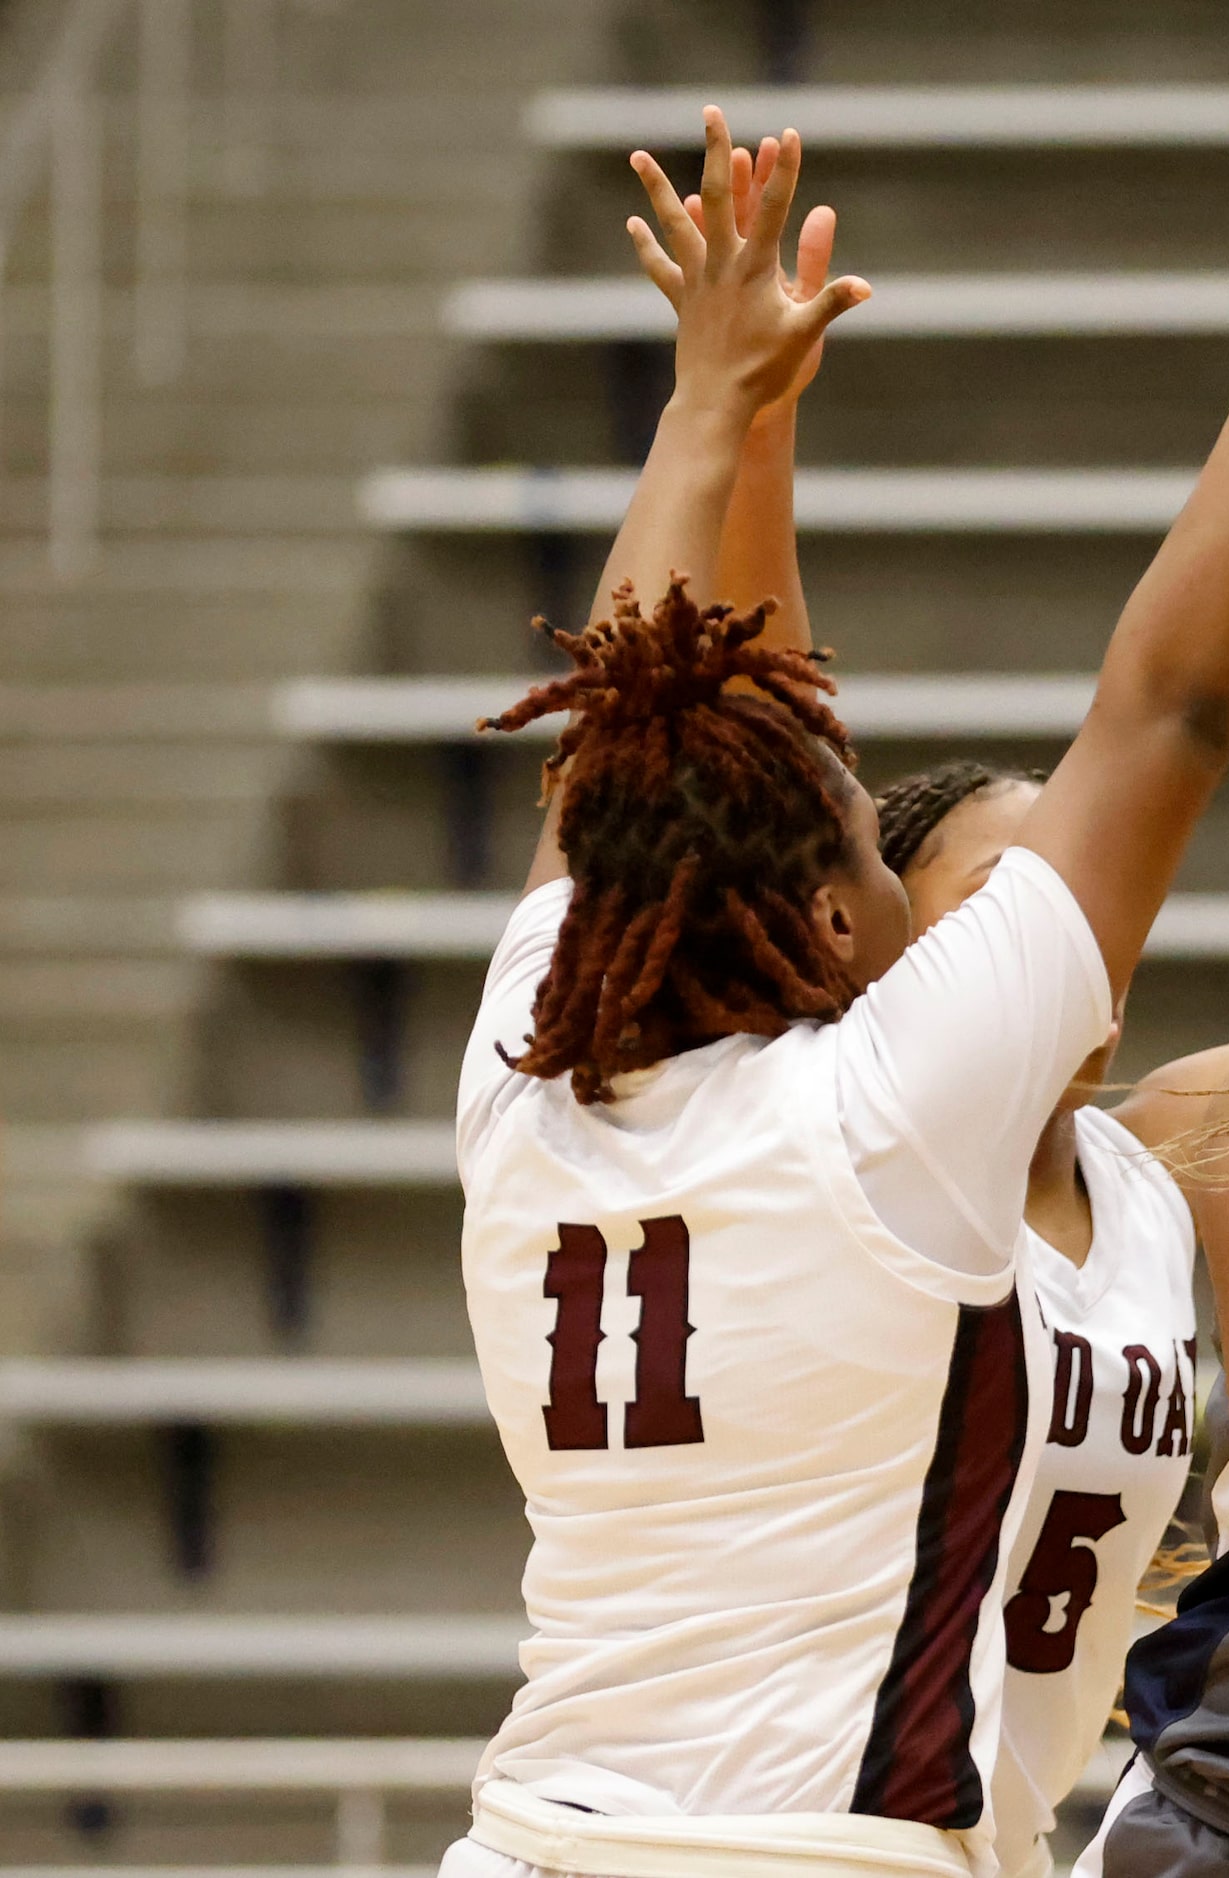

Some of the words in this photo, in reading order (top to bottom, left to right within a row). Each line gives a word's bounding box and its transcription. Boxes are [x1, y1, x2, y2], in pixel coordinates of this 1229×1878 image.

[541, 1214, 705, 1451] 11
[1120, 1332, 1197, 1458] OA
[1002, 1489, 1128, 1674] 5
